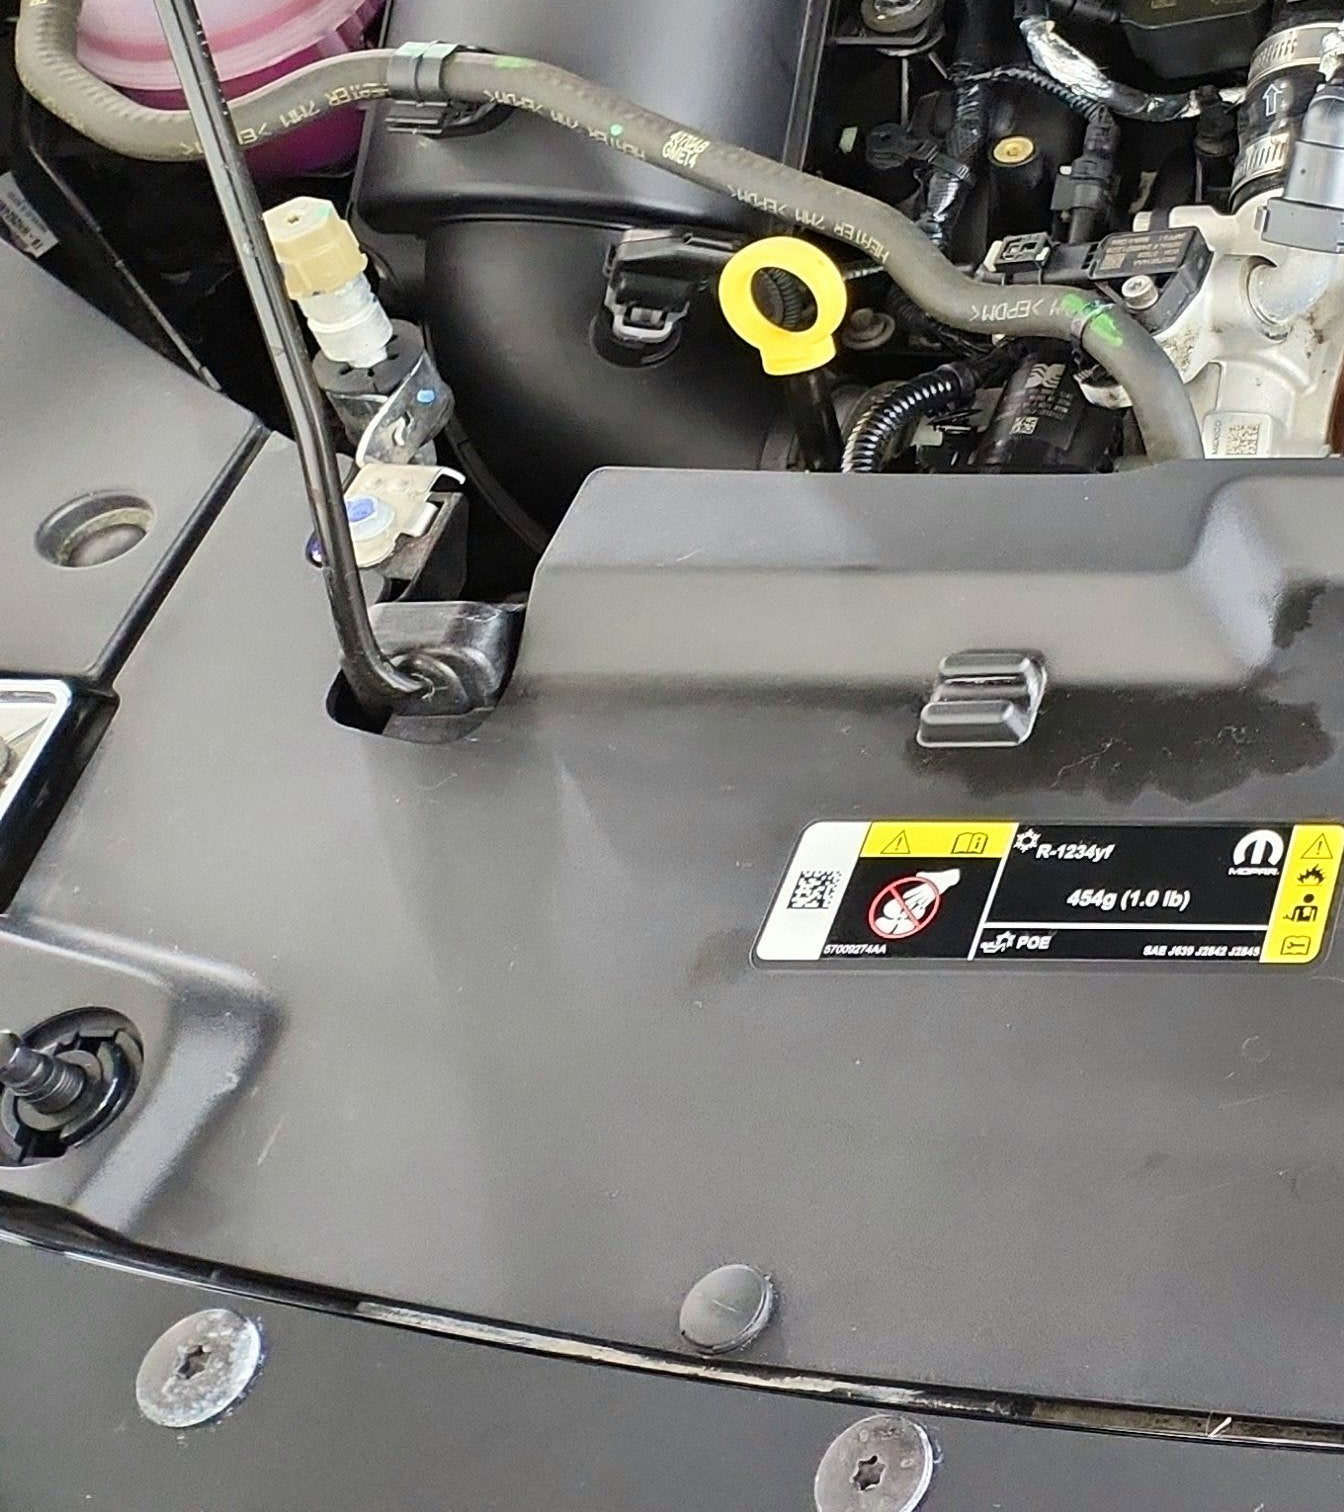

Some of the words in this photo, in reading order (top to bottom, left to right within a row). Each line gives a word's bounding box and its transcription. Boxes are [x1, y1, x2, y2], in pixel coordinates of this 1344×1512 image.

[795, 207, 826, 231] 7MM
[833, 221, 890, 265] HEATER
[968, 298, 1044, 323] >EPDM<
[1035, 843, 1116, 863] R-1234yf
[1065, 888, 1118, 911] 454g
[1119, 889, 1157, 911] (1.0
[1161, 889, 1191, 912] lb)
[1015, 934, 1053, 950] POE
[1142, 944, 1169, 957] SAE
